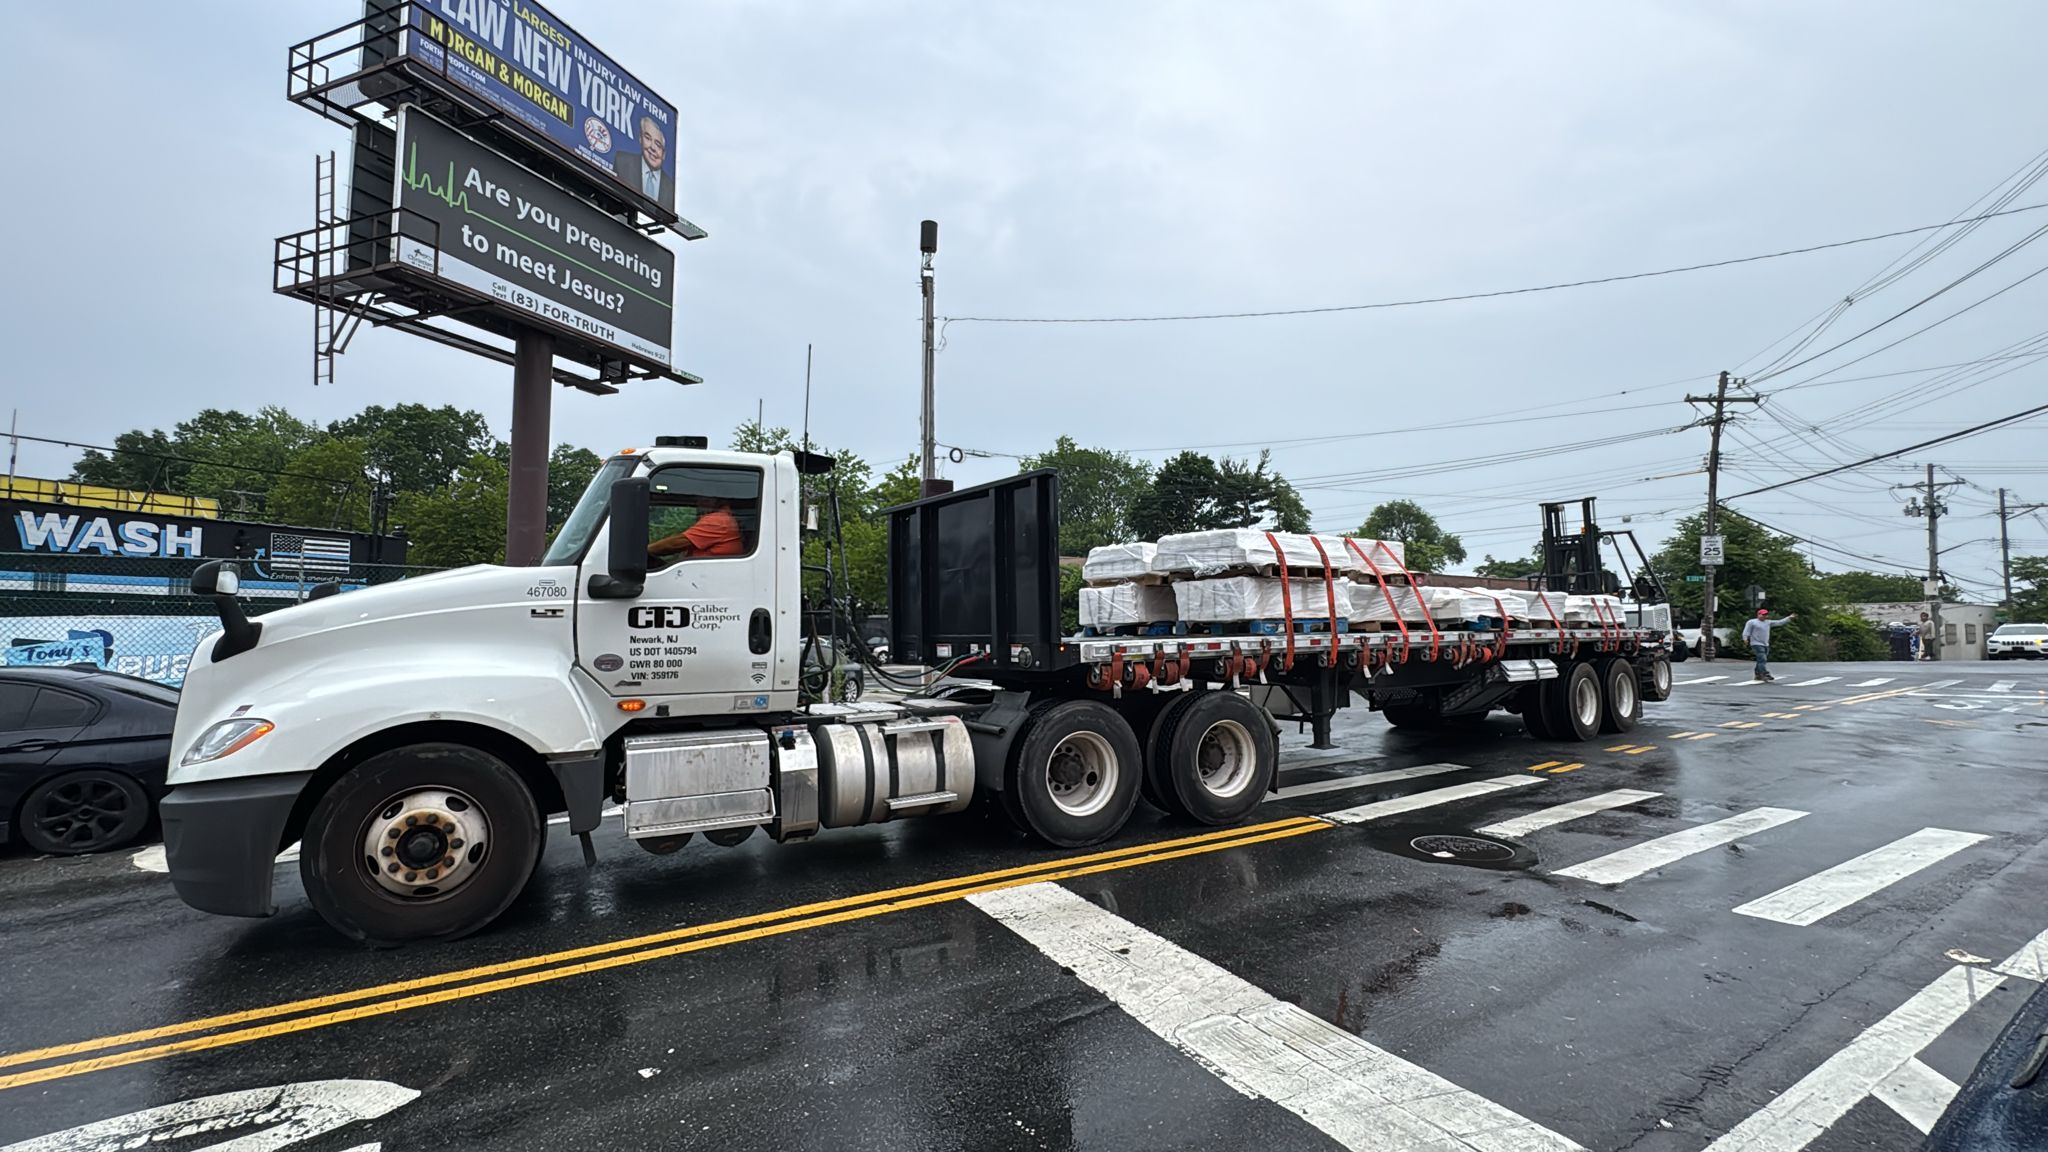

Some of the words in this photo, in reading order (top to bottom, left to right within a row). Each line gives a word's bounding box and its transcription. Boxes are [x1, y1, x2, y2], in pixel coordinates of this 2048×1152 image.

[420, 38, 486, 84] FORTHEOPLE.COM
[513, 1, 572, 52] LARGEST
[574, 45, 616, 84] INJURY
[618, 78, 641, 104] LAW
[642, 97, 668, 124] FIRM
[513, 17, 572, 95] NEW
[577, 62, 635, 140] YORK
[499, 63, 510, 83] &
[513, 71, 568, 121] MORGAN
[464, 167, 511, 207] Are
[516, 196, 561, 234] you
[566, 222, 662, 288] preparing
[461, 224, 489, 254] to
[496, 242, 556, 285] meet
[560, 267, 625, 314] Jesus?
[492, 289, 507, 299] Text
[492, 282, 507, 293] Call
[511, 290, 539, 312] (83)
[543, 303, 615, 342] FOR-TRUTH
[14, 510, 203, 558] WASH
[1704, 547, 1721, 556] 25
[270, 572, 306, 581] Entrane
[527, 586, 567, 597] 467080
[531, 608, 564, 617] LT
[691, 605, 728, 614] Caliber
[691, 613, 740, 622] Transport
[691, 621, 721, 631] Corp.
[629, 635, 664, 644] Newark,
[666, 635, 679, 644] NJ
[20, 642, 92, 662] Tony's
[629, 648, 642, 656] US
[644, 647, 661, 656] DOT
[664, 646, 697, 655] 1405794
[629, 660, 651, 669] GWR
[653, 660, 663, 668] 80
[666, 659, 683, 668] 000
[631, 672, 649, 680] VIN:
[651, 671, 679, 680] 359176
